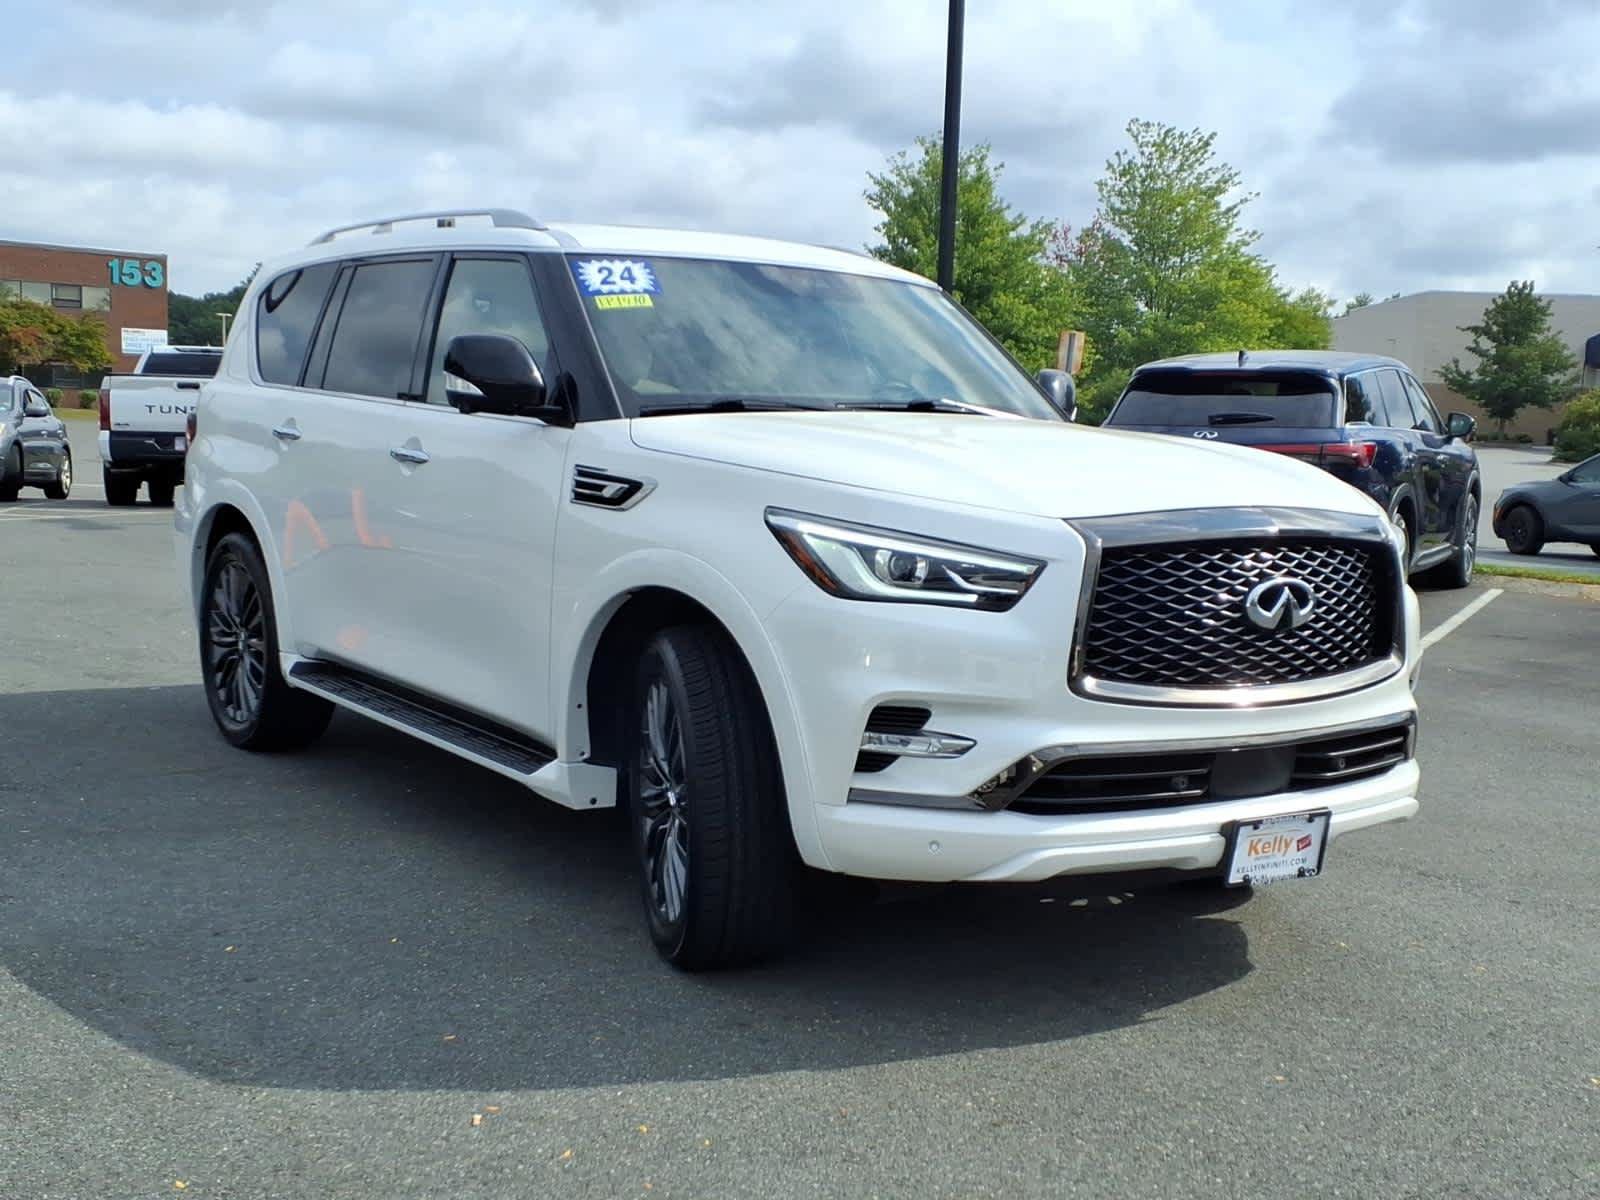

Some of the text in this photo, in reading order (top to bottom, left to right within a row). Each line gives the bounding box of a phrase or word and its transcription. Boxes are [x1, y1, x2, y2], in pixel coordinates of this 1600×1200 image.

[108, 258, 163, 288] 153
[597, 266, 636, 285] 24
[1247, 835, 1294, 857] Kelly
